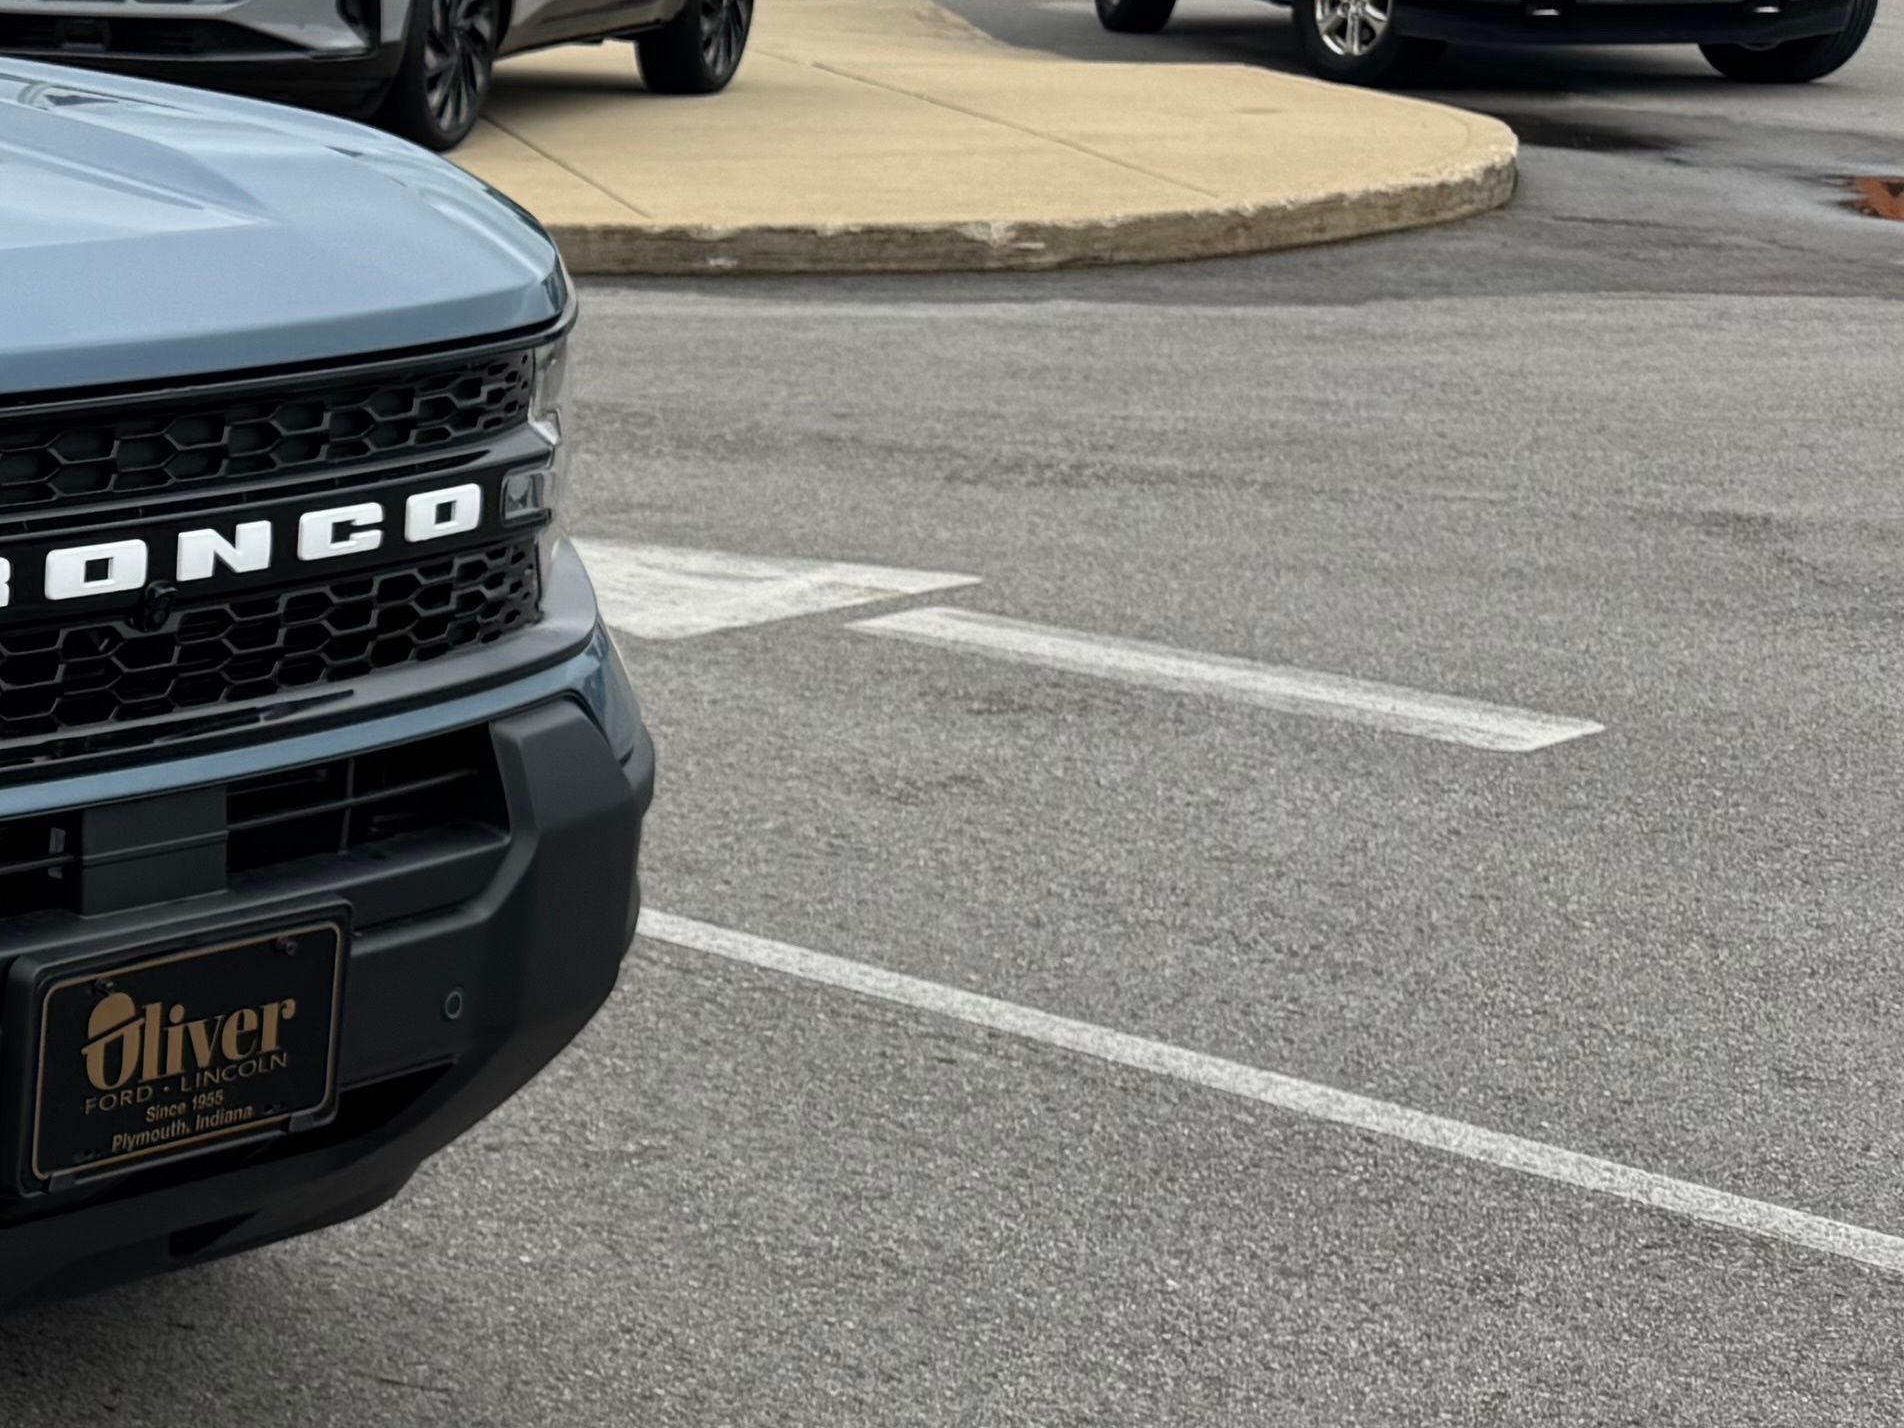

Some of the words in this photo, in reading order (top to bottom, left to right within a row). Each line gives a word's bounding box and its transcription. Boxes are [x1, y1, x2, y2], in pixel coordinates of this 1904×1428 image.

[81, 991, 297, 1091] Oliver
[84, 1085, 153, 1115] FORD
[181, 1052, 288, 1091] LINCOLN
[145, 1101, 187, 1122] Since
[192, 1089, 224, 1111] 1955
[195, 1103, 254, 1131] Indiana
